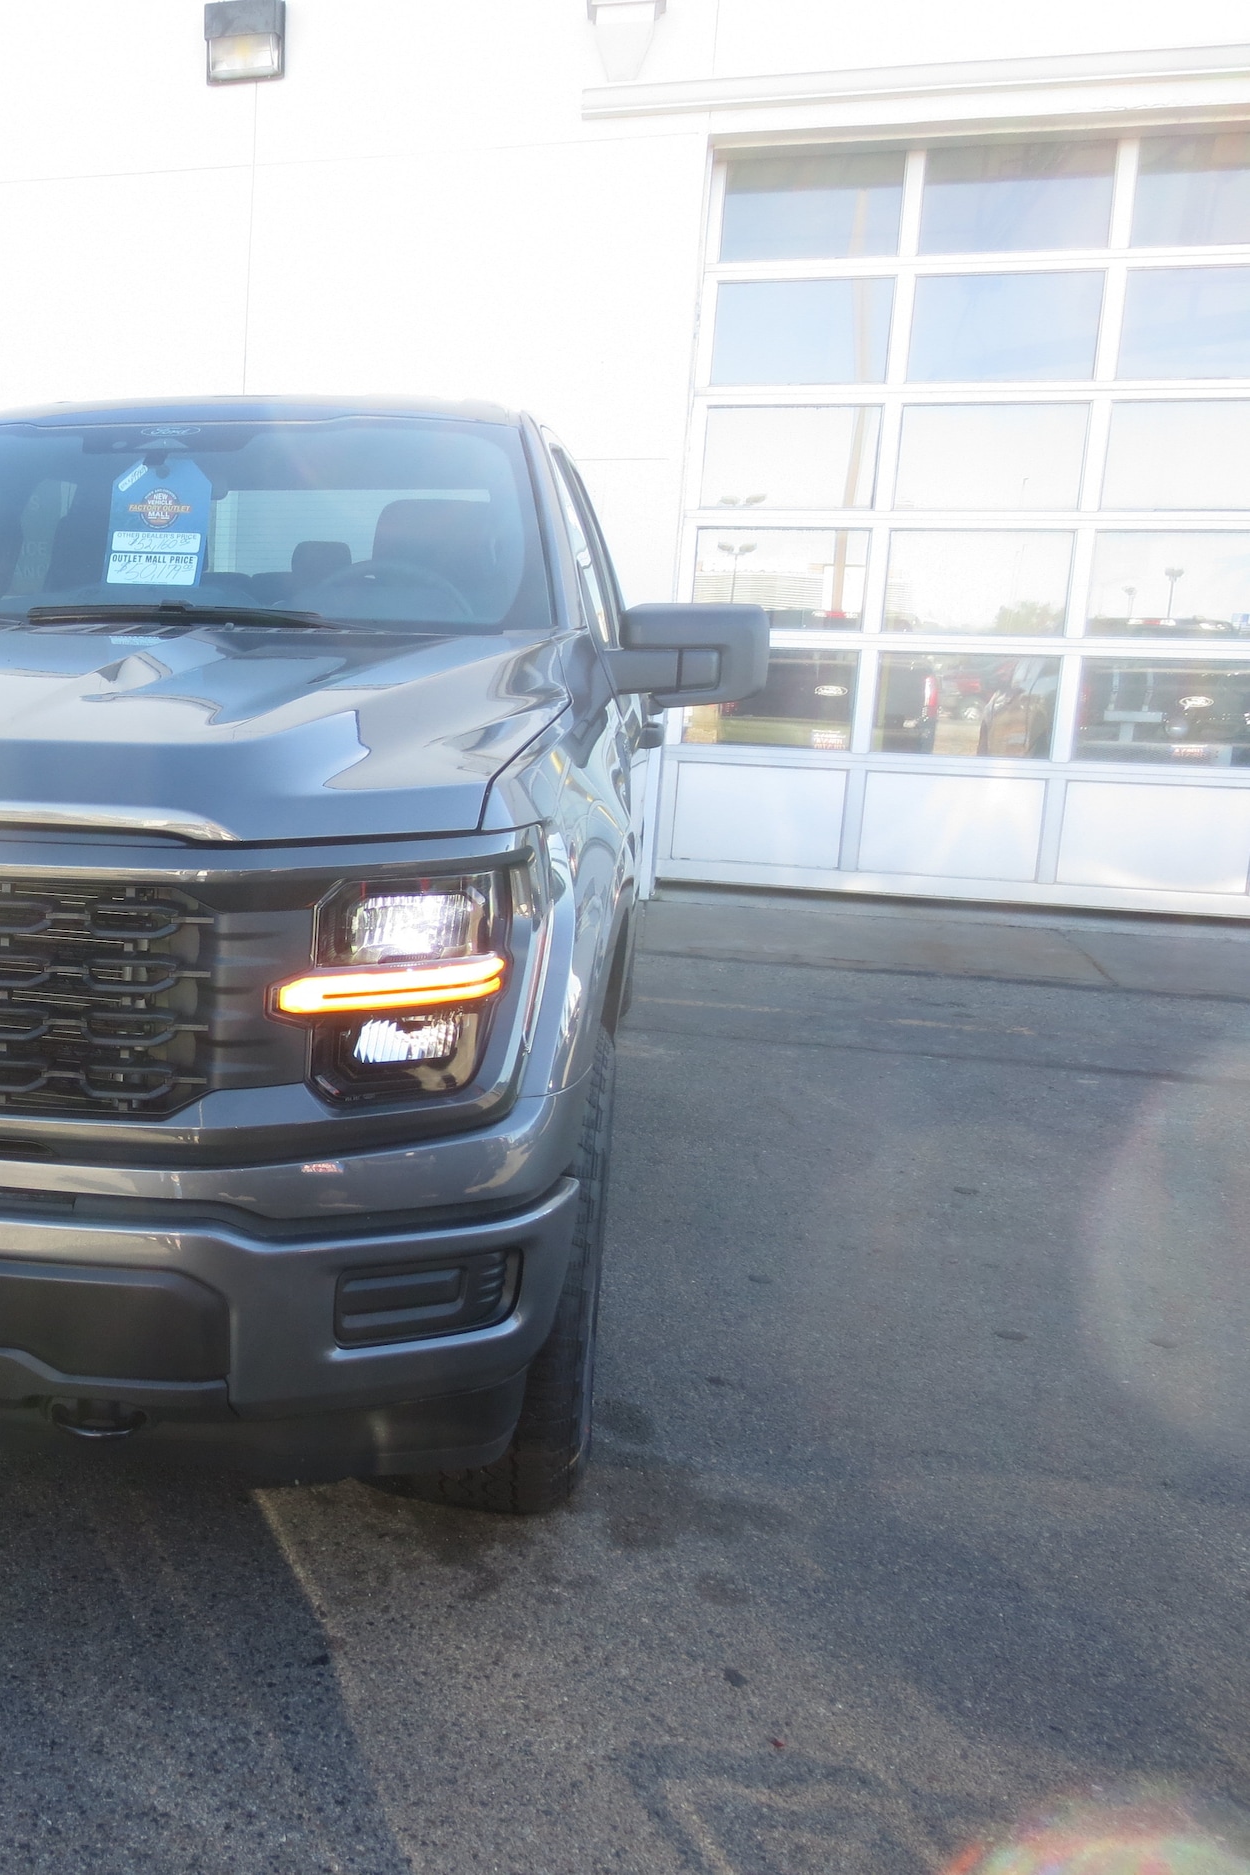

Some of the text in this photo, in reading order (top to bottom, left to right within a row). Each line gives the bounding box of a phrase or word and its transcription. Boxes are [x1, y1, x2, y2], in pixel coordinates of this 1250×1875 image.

[153, 492, 169, 500] NEW
[112, 554, 194, 564] OUTLET MALL PRICE
